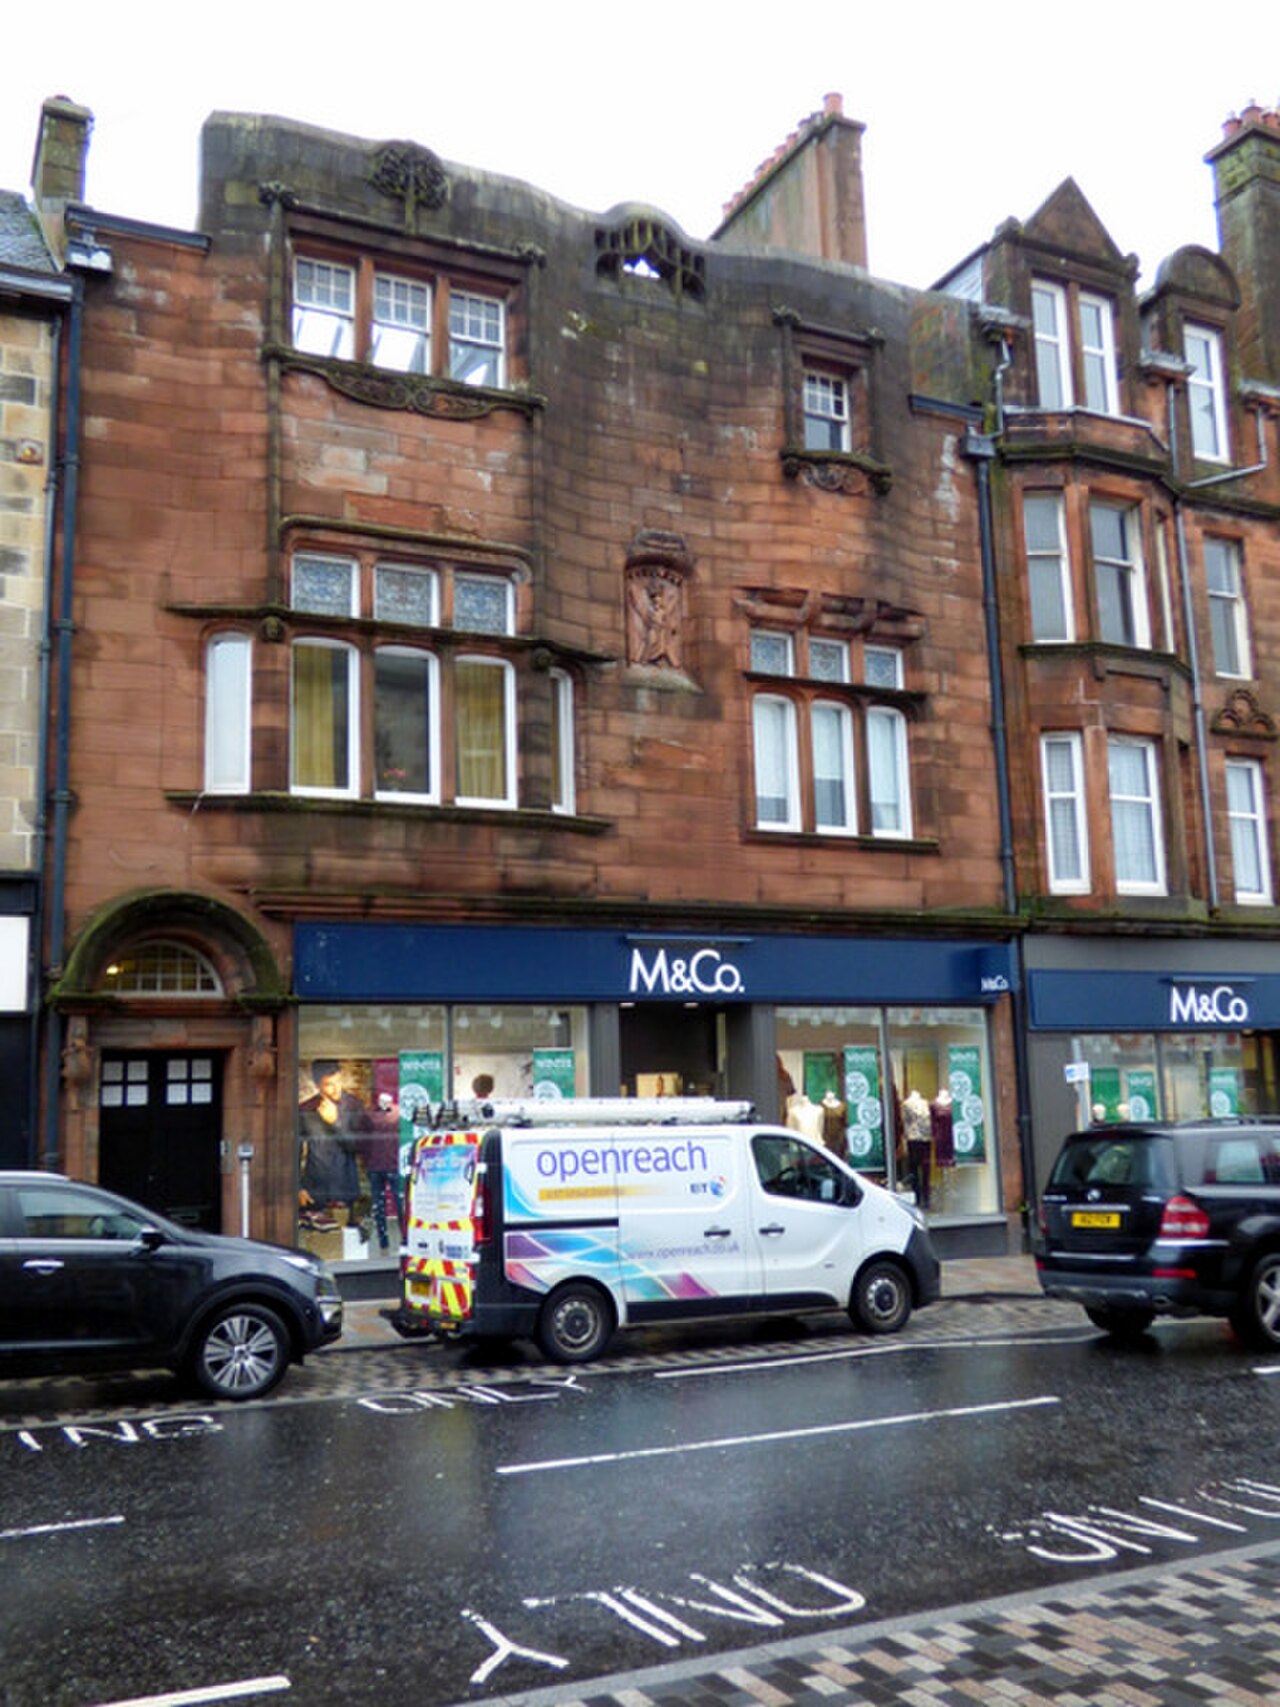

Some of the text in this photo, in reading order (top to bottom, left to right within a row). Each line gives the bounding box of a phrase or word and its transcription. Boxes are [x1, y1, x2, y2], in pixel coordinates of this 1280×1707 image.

[629, 948, 745, 993] M&Co.
[1170, 985, 1249, 1023] M&Co
[536, 1140, 708, 1183] openreach
[357, 1375, 593, 1414] ONLY
[460, 1563, 866, 1684] ONLY
